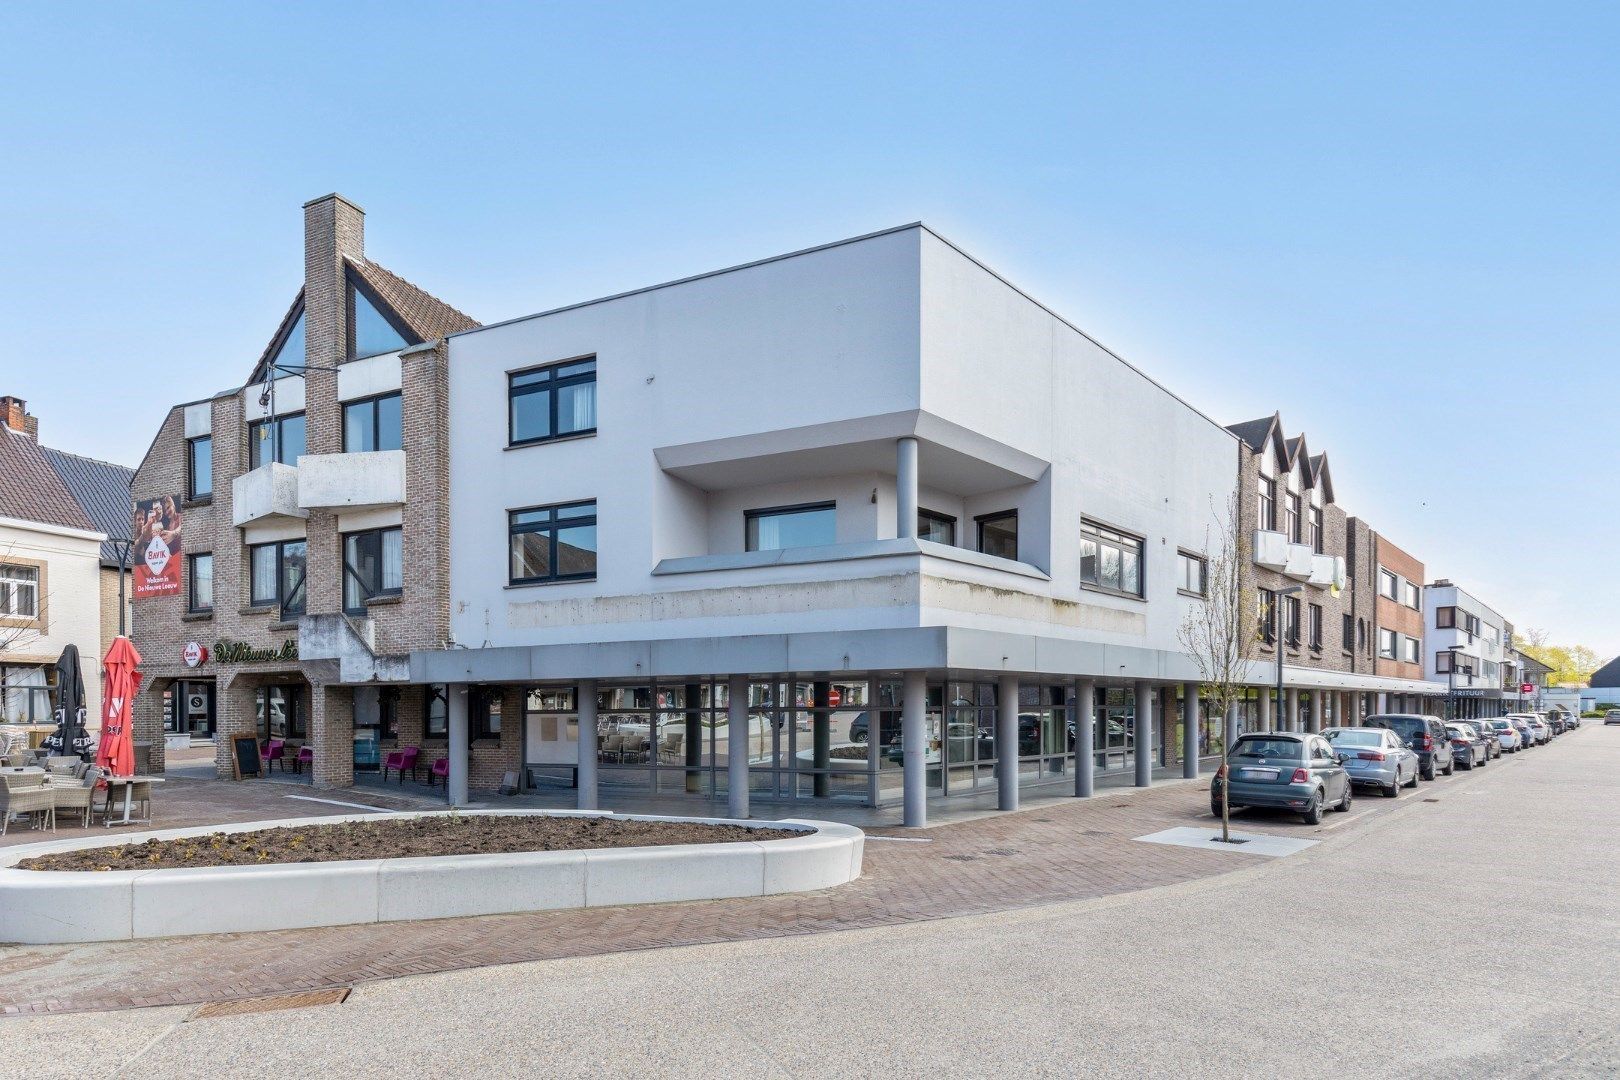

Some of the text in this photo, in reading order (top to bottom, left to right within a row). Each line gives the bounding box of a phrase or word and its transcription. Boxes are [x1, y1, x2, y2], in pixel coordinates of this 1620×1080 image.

[148, 550, 167, 560] BAVIK
[146, 576, 164, 584] Welkom
[145, 584, 162, 592] Nieuwe
[162, 582, 178, 590] Leeuw
[213, 639, 299, 663] De Nieuwe Lee
